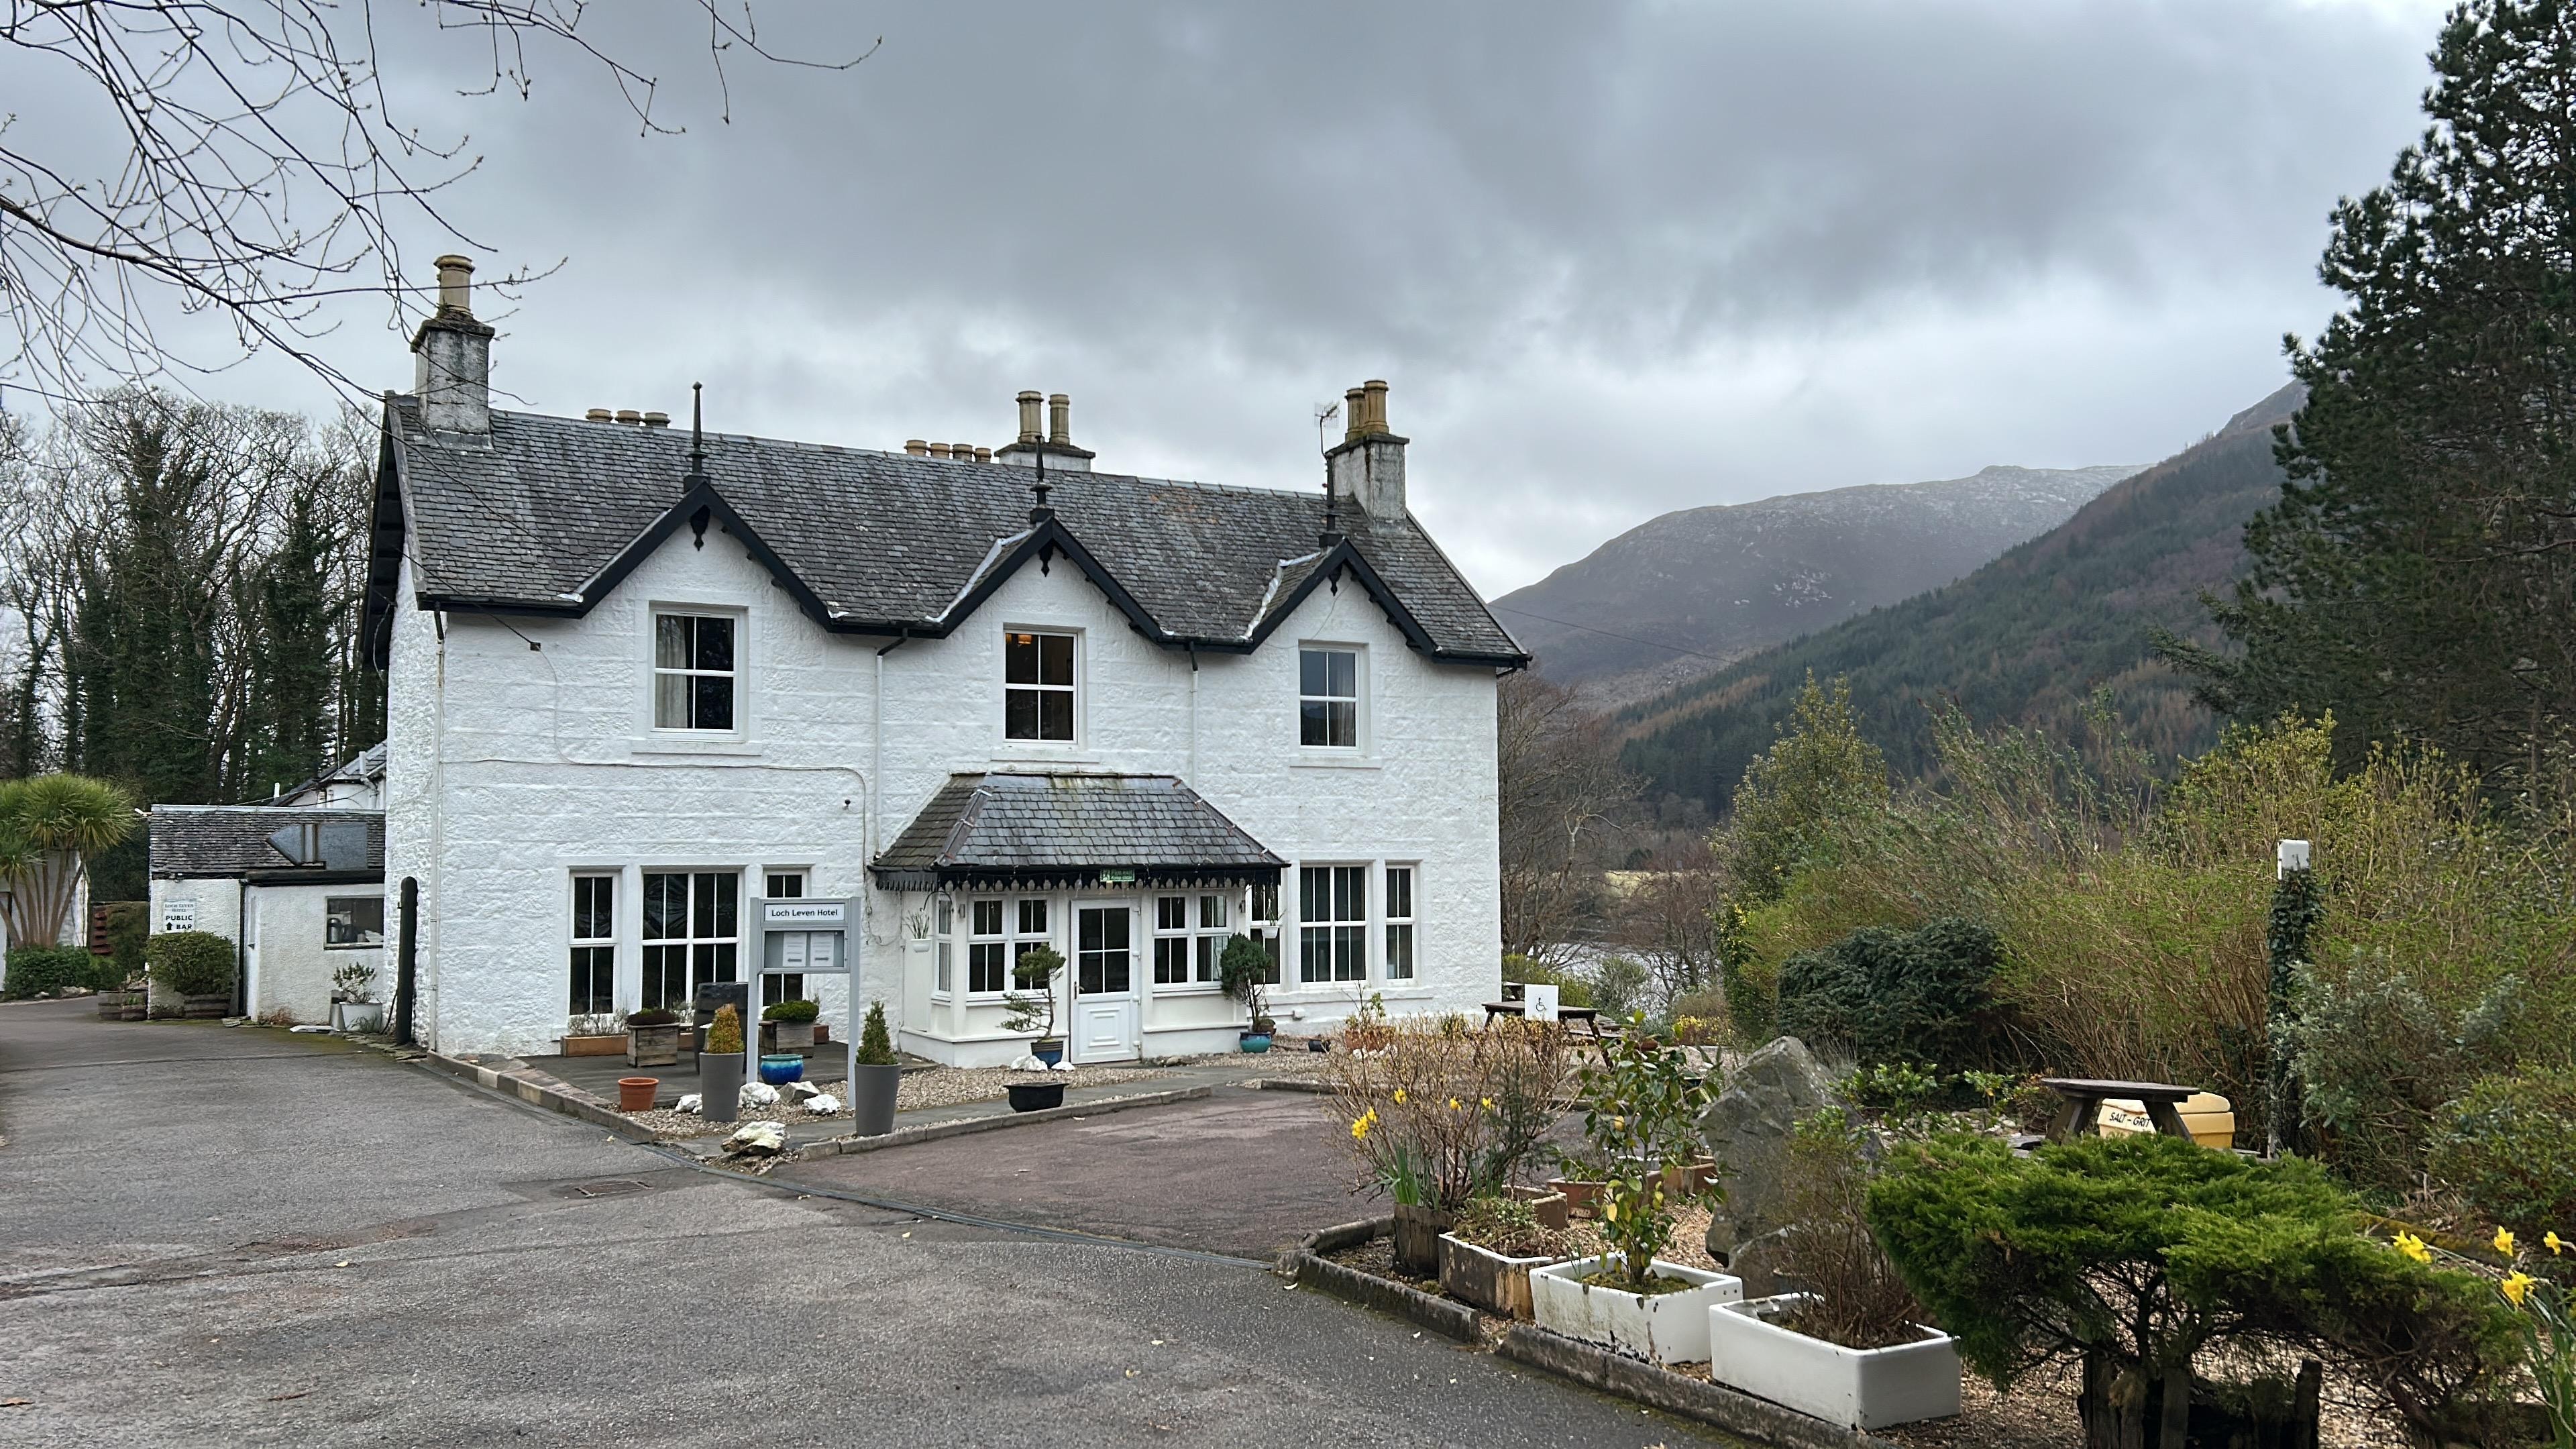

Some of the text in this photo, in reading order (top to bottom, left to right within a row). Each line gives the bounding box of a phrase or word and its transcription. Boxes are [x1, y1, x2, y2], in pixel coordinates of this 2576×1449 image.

[817, 908, 838, 916] Hotel
[2109, 1112, 2127, 1123] SALT
[2133, 1116, 2151, 1128] GRIT
